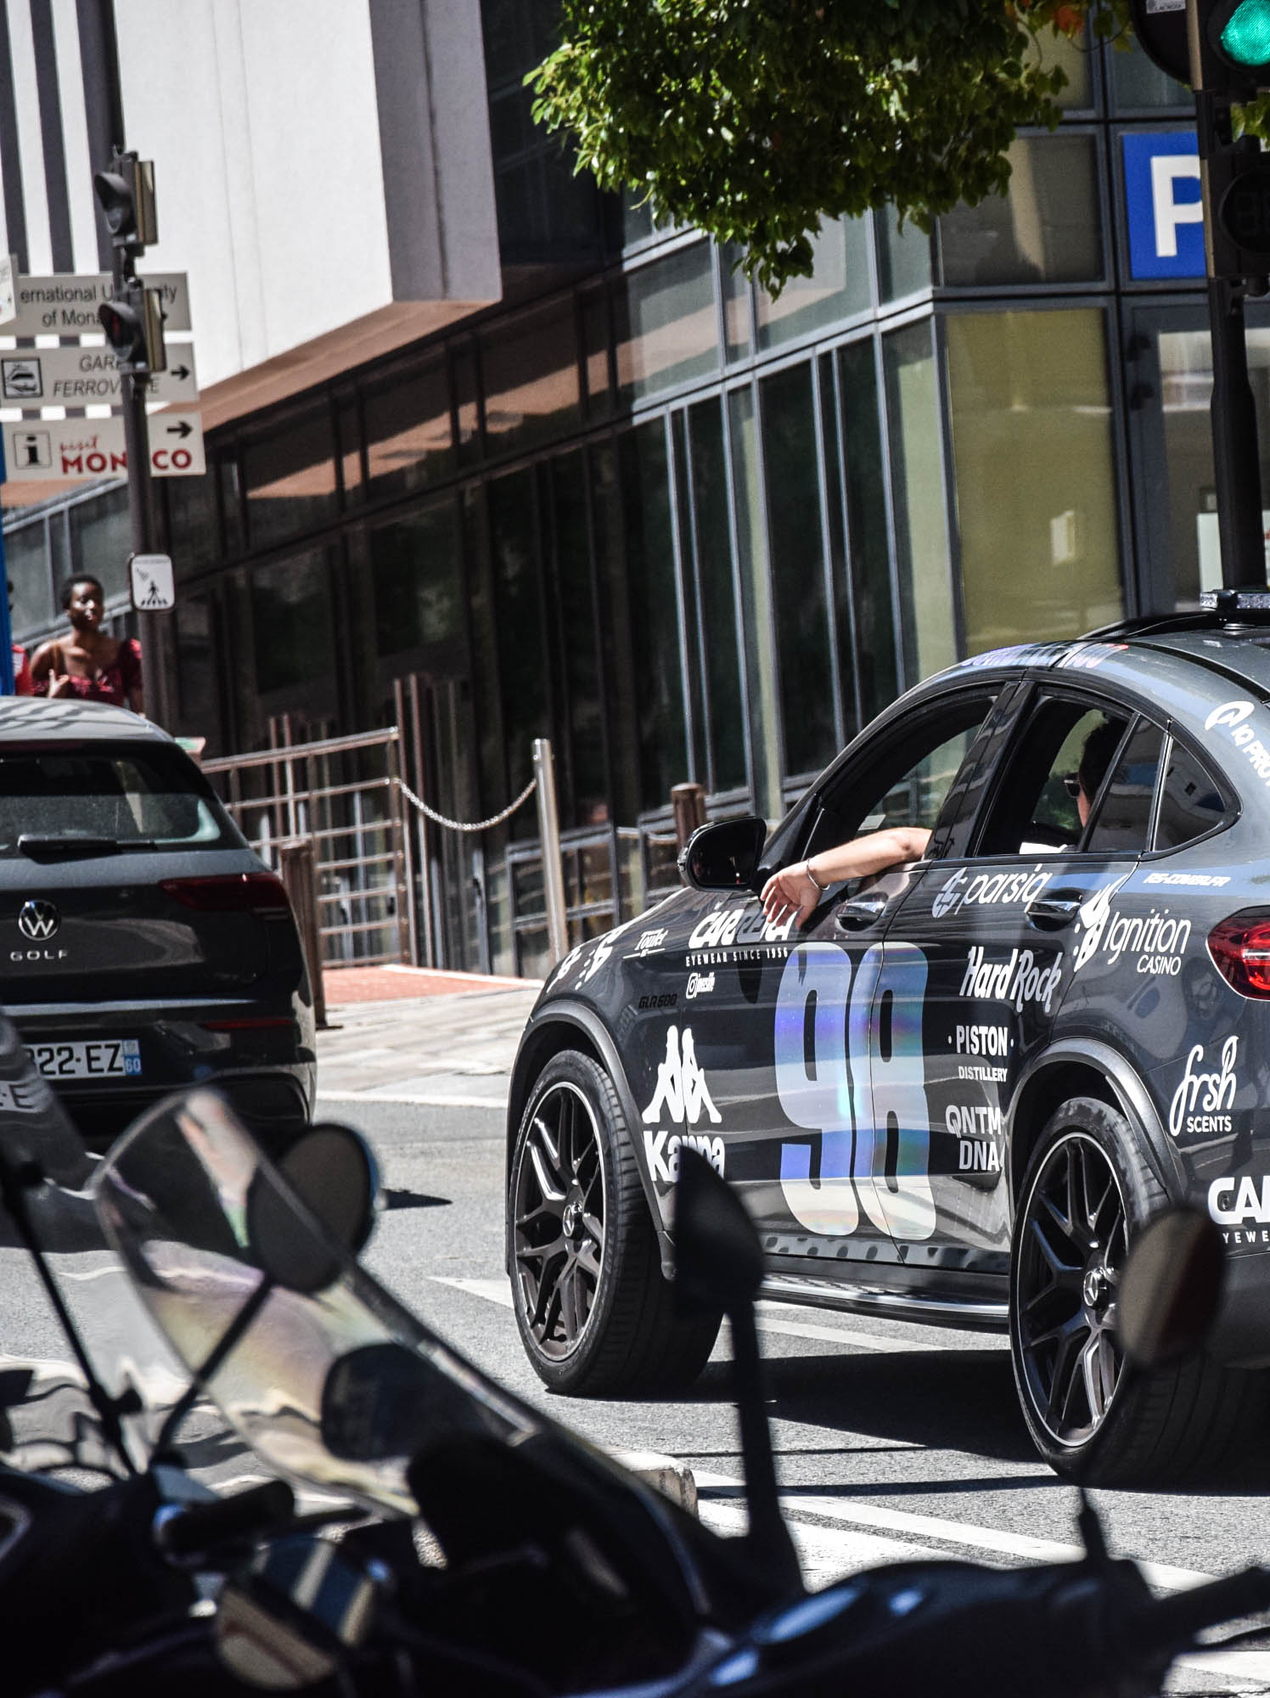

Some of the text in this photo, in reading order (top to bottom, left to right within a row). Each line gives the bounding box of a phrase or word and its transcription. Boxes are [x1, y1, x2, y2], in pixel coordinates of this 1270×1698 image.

[1150, 155, 1204, 257] P
[20, 284, 97, 303] ernational
[41, 309, 59, 326] of
[79, 353, 118, 373] GAR
[60, 448, 193, 475] MONCO
[954, 864, 1054, 915] parsiq
[1102, 909, 1192, 965] Ignition
[10, 949, 69, 961] GOLF
[686, 947, 788, 967] EYEWEAR SINCE 1956
[1136, 954, 1182, 975] CASINO
[959, 946, 1063, 1013] Hard Rock
[956, 1025, 1008, 1057] PISTON
[958, 1066, 1008, 1082] DISTILLERY
[773, 941, 936, 1240] 98
[945, 1104, 1002, 1139] QNTM
[1186, 1115, 1232, 1133] SCENTS
[959, 1139, 1001, 1172] DNA
